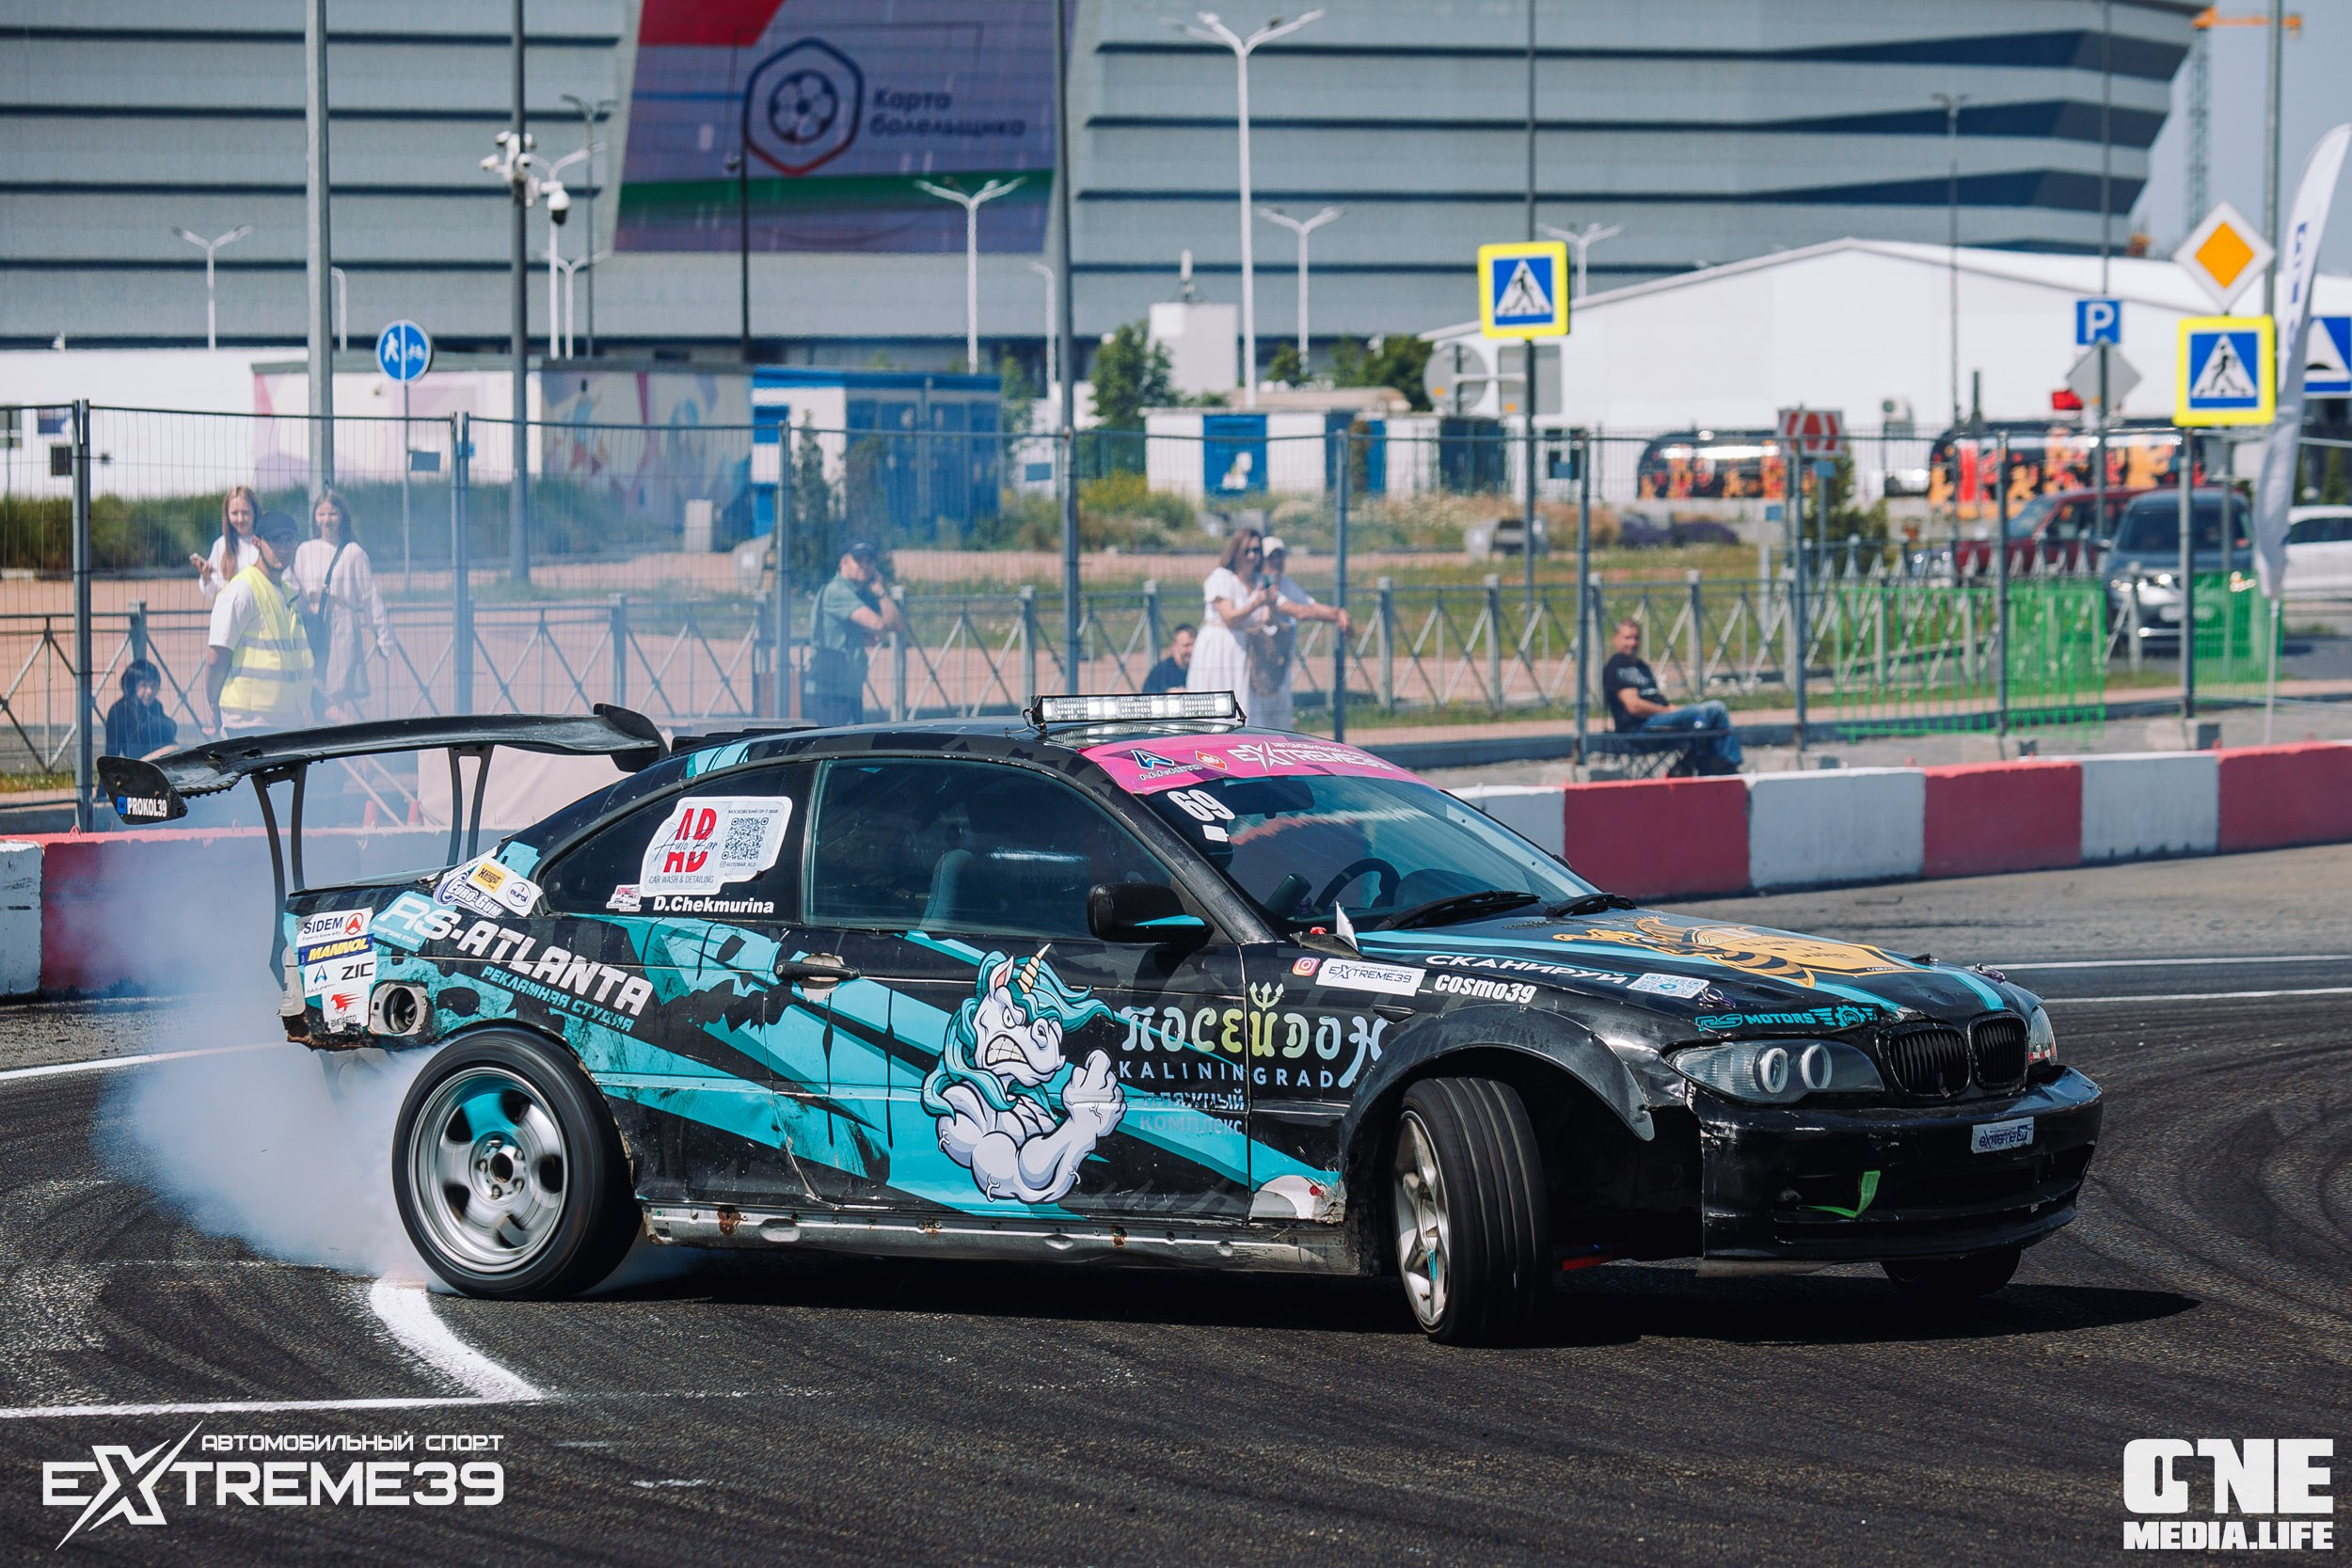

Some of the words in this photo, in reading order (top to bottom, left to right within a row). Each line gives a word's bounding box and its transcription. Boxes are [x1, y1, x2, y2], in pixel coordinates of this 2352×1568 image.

[873, 87, 953, 112] Карта
[2086, 303, 2116, 341] P
[127, 797, 167, 817] PROKOL39
[1168, 789, 1235, 822] 69
[478, 867, 501, 884] Hengst
[649, 876, 661, 884] CAR
[661, 876, 677, 884] WASH
[678, 876, 684, 884] &
[685, 875, 714, 884] DETAILING
[447, 879, 505, 917] EURO-GUM
[653, 896, 774, 913] D.Chekmurina
[304, 916, 344, 934] SIDEM
[308, 937, 369, 961] MANNOL
[378, 895, 654, 1016] RS-ATLANTA
[341, 961, 374, 981] ZIC
[1328, 964, 1412, 983] EXTREME39
[1425, 956, 1628, 985] СКАНИРУЙ
[481, 965, 571, 1008] РЕКЛАМНАЯ
[571, 999, 635, 1033] СТУДИЯ
[1743, 1013, 1817, 1024] MOTORS
[1120, 1061, 1334, 1088] KALININGRAD
